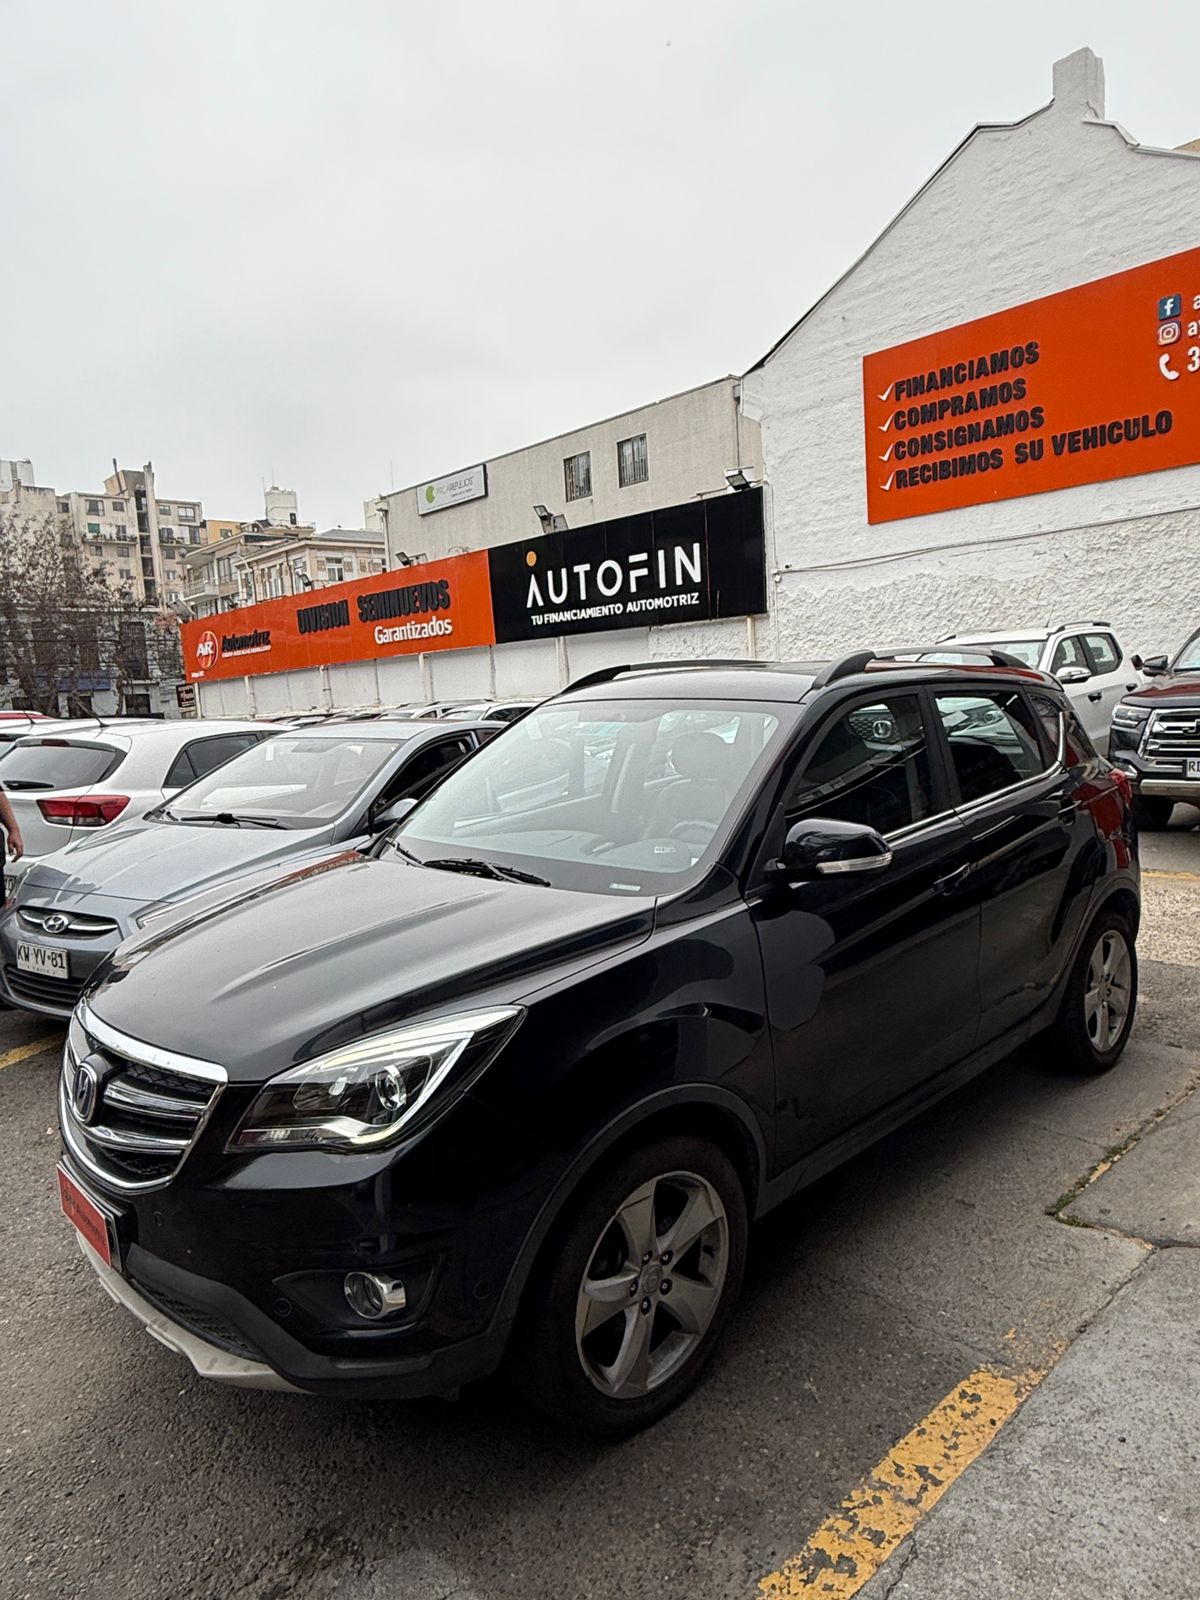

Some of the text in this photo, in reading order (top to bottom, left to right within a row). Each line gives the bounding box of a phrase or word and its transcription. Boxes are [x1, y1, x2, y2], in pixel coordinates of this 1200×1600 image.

[894, 341, 1040, 401] FINANCIAMOS
[894, 378, 1027, 430] COMPRAMOS
[894, 406, 1045, 461] CONSIGNAMOS
[895, 410, 1173, 490] RECIBIMOS SU VEHICULO
[357, 578, 450, 623] SEMINUEVOS
[526, 542, 702, 609] AUTOFIN
[374, 615, 453, 645] Garantizados
[531, 592, 700, 626] TU FINANCIAMIENTO AUTOMOTRIZ
[196, 641, 214, 657] AR
